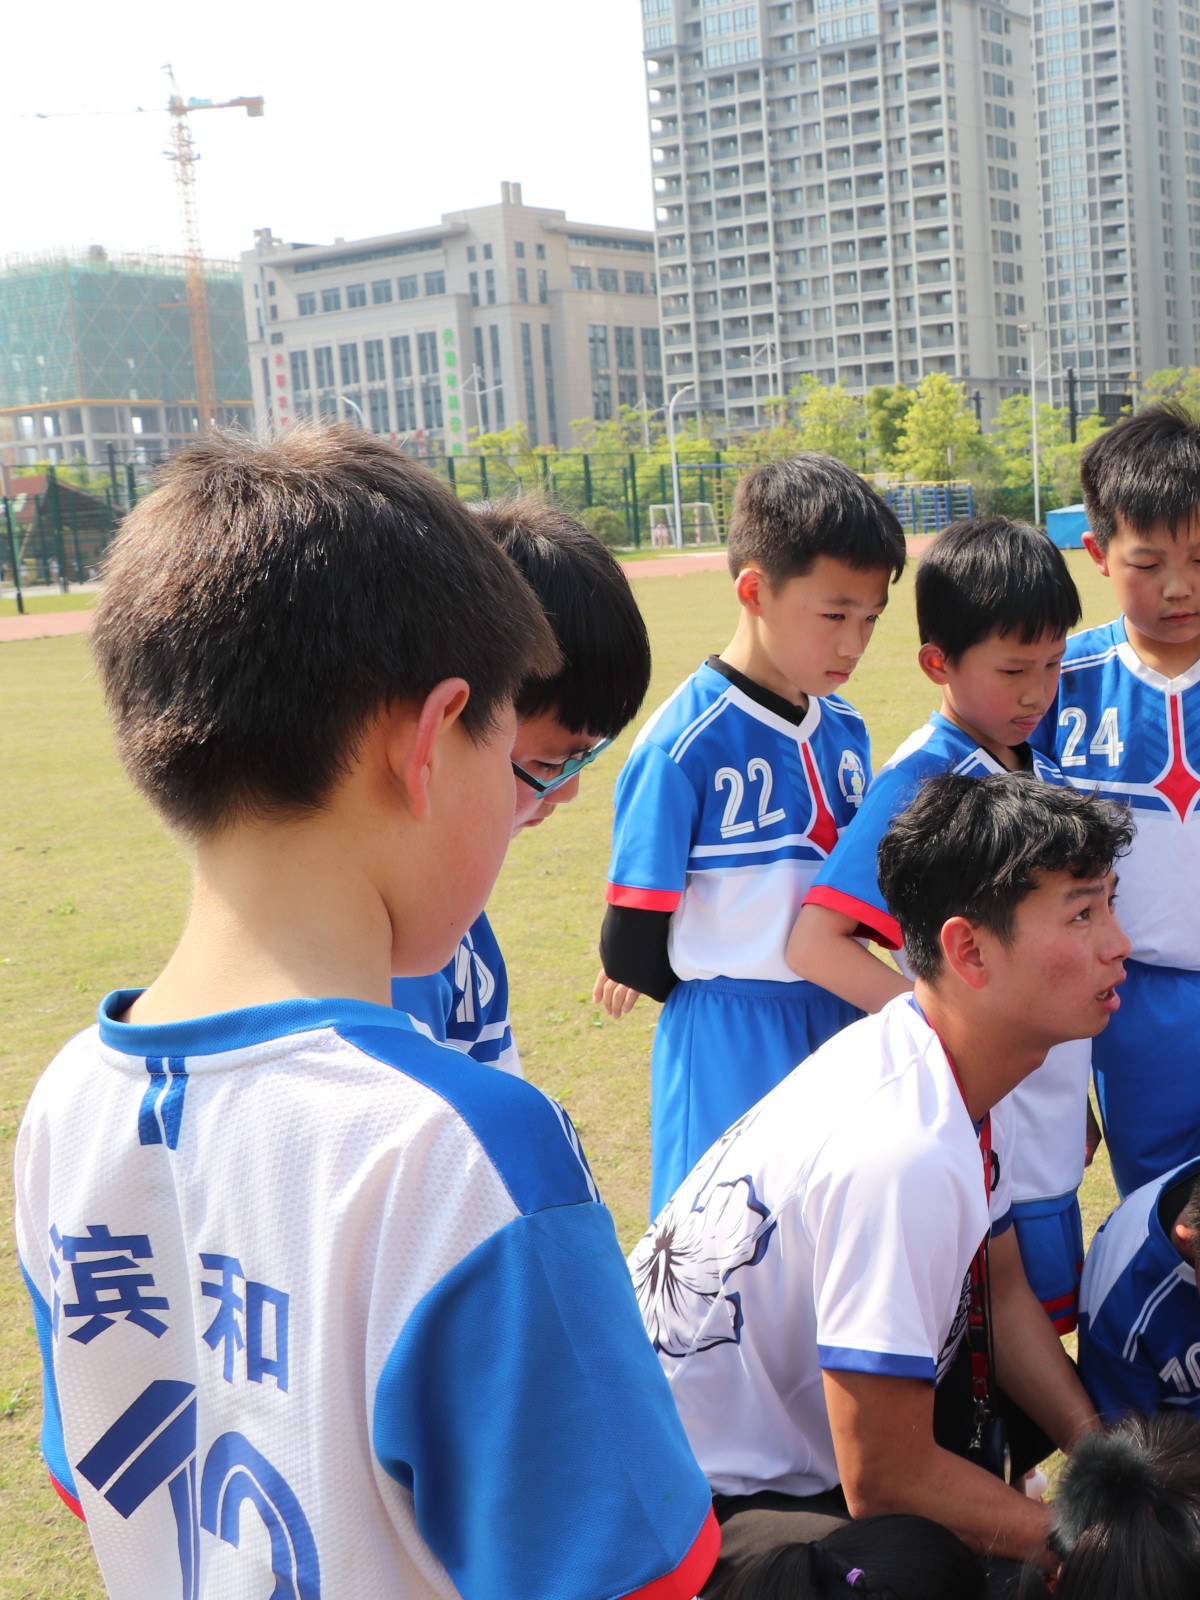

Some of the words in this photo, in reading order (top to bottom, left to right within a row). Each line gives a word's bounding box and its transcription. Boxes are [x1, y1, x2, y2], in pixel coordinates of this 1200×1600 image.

[1059, 707, 1124, 768] 24
[714, 757, 786, 839] 22
[50, 1223, 291, 1394] 滨和
